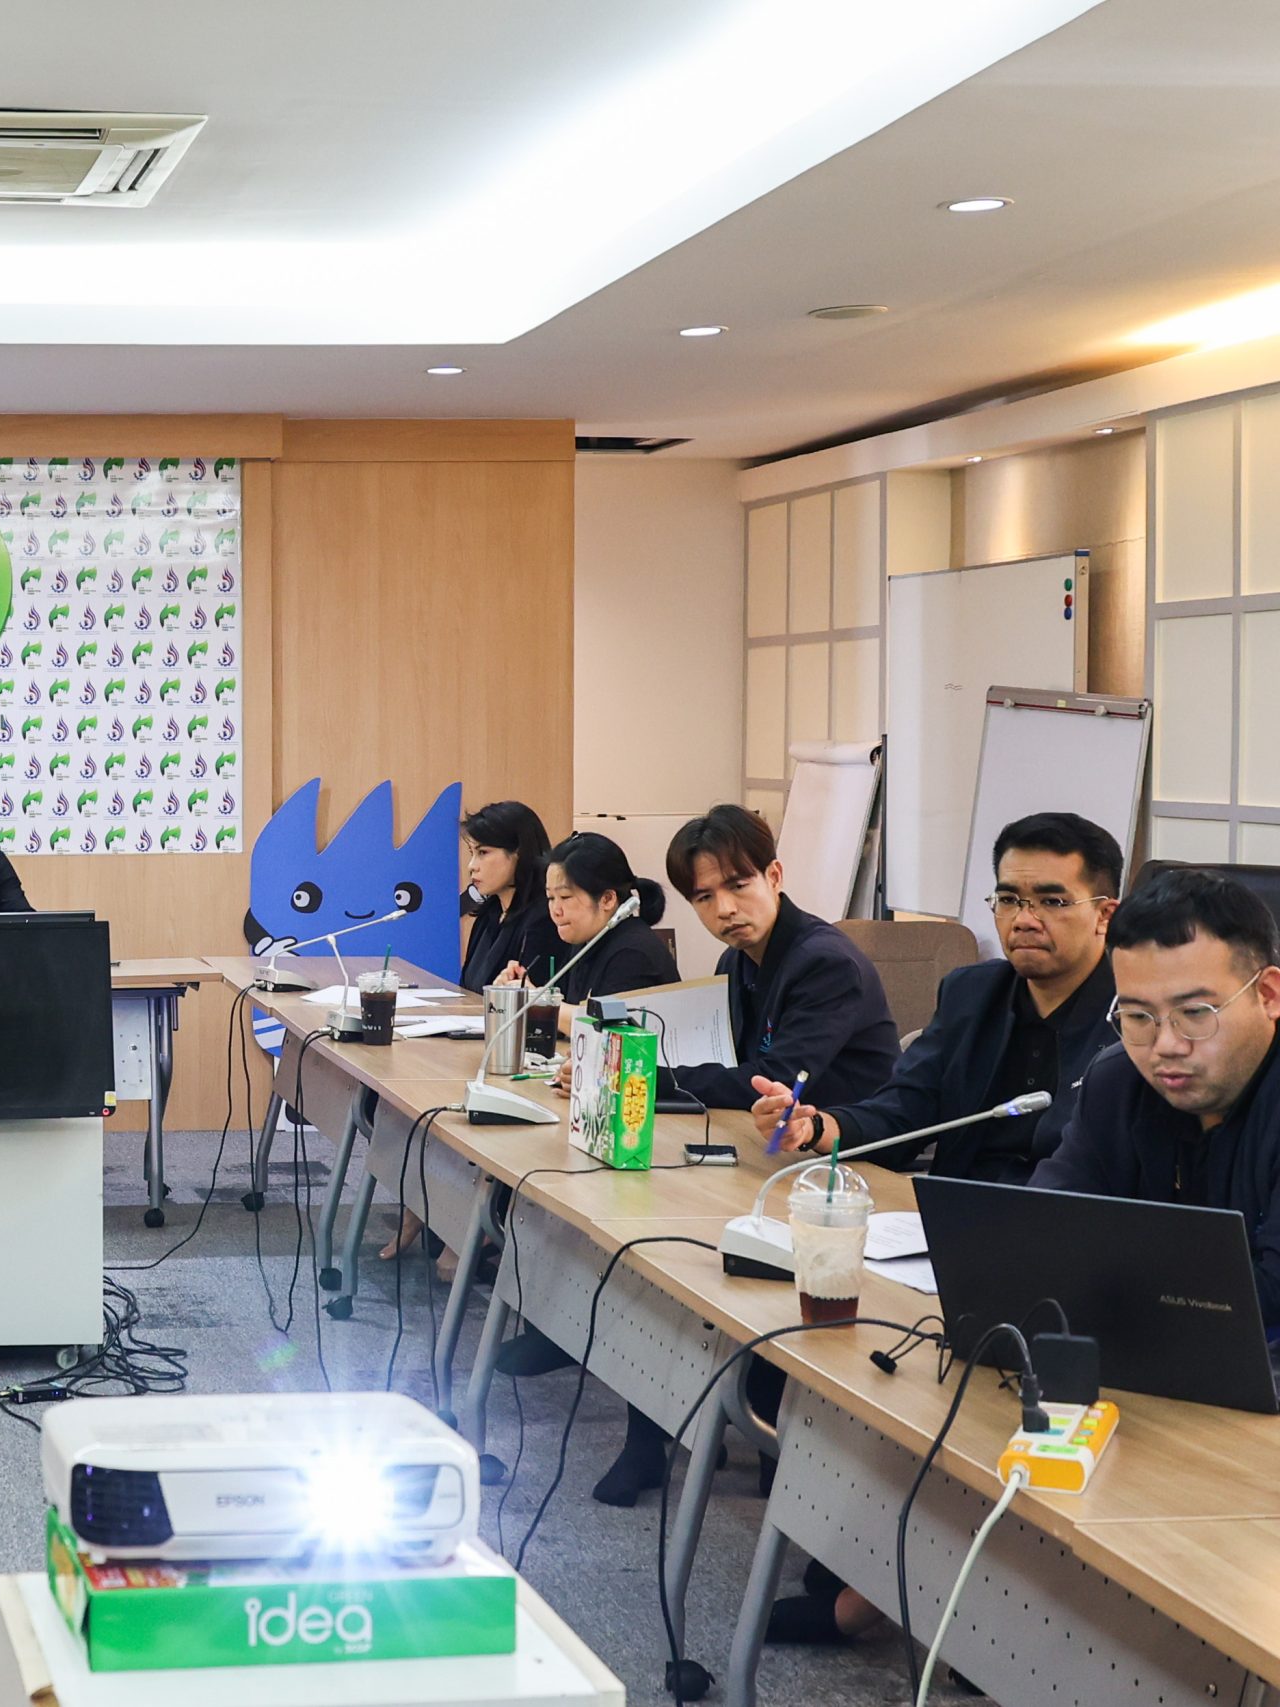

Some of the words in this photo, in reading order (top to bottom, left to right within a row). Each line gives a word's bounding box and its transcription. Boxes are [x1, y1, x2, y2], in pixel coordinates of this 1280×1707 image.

[1160, 1295, 1186, 1306] ASUS
[216, 1495, 265, 1507] EPSON
[244, 1590, 373, 1647] idea
